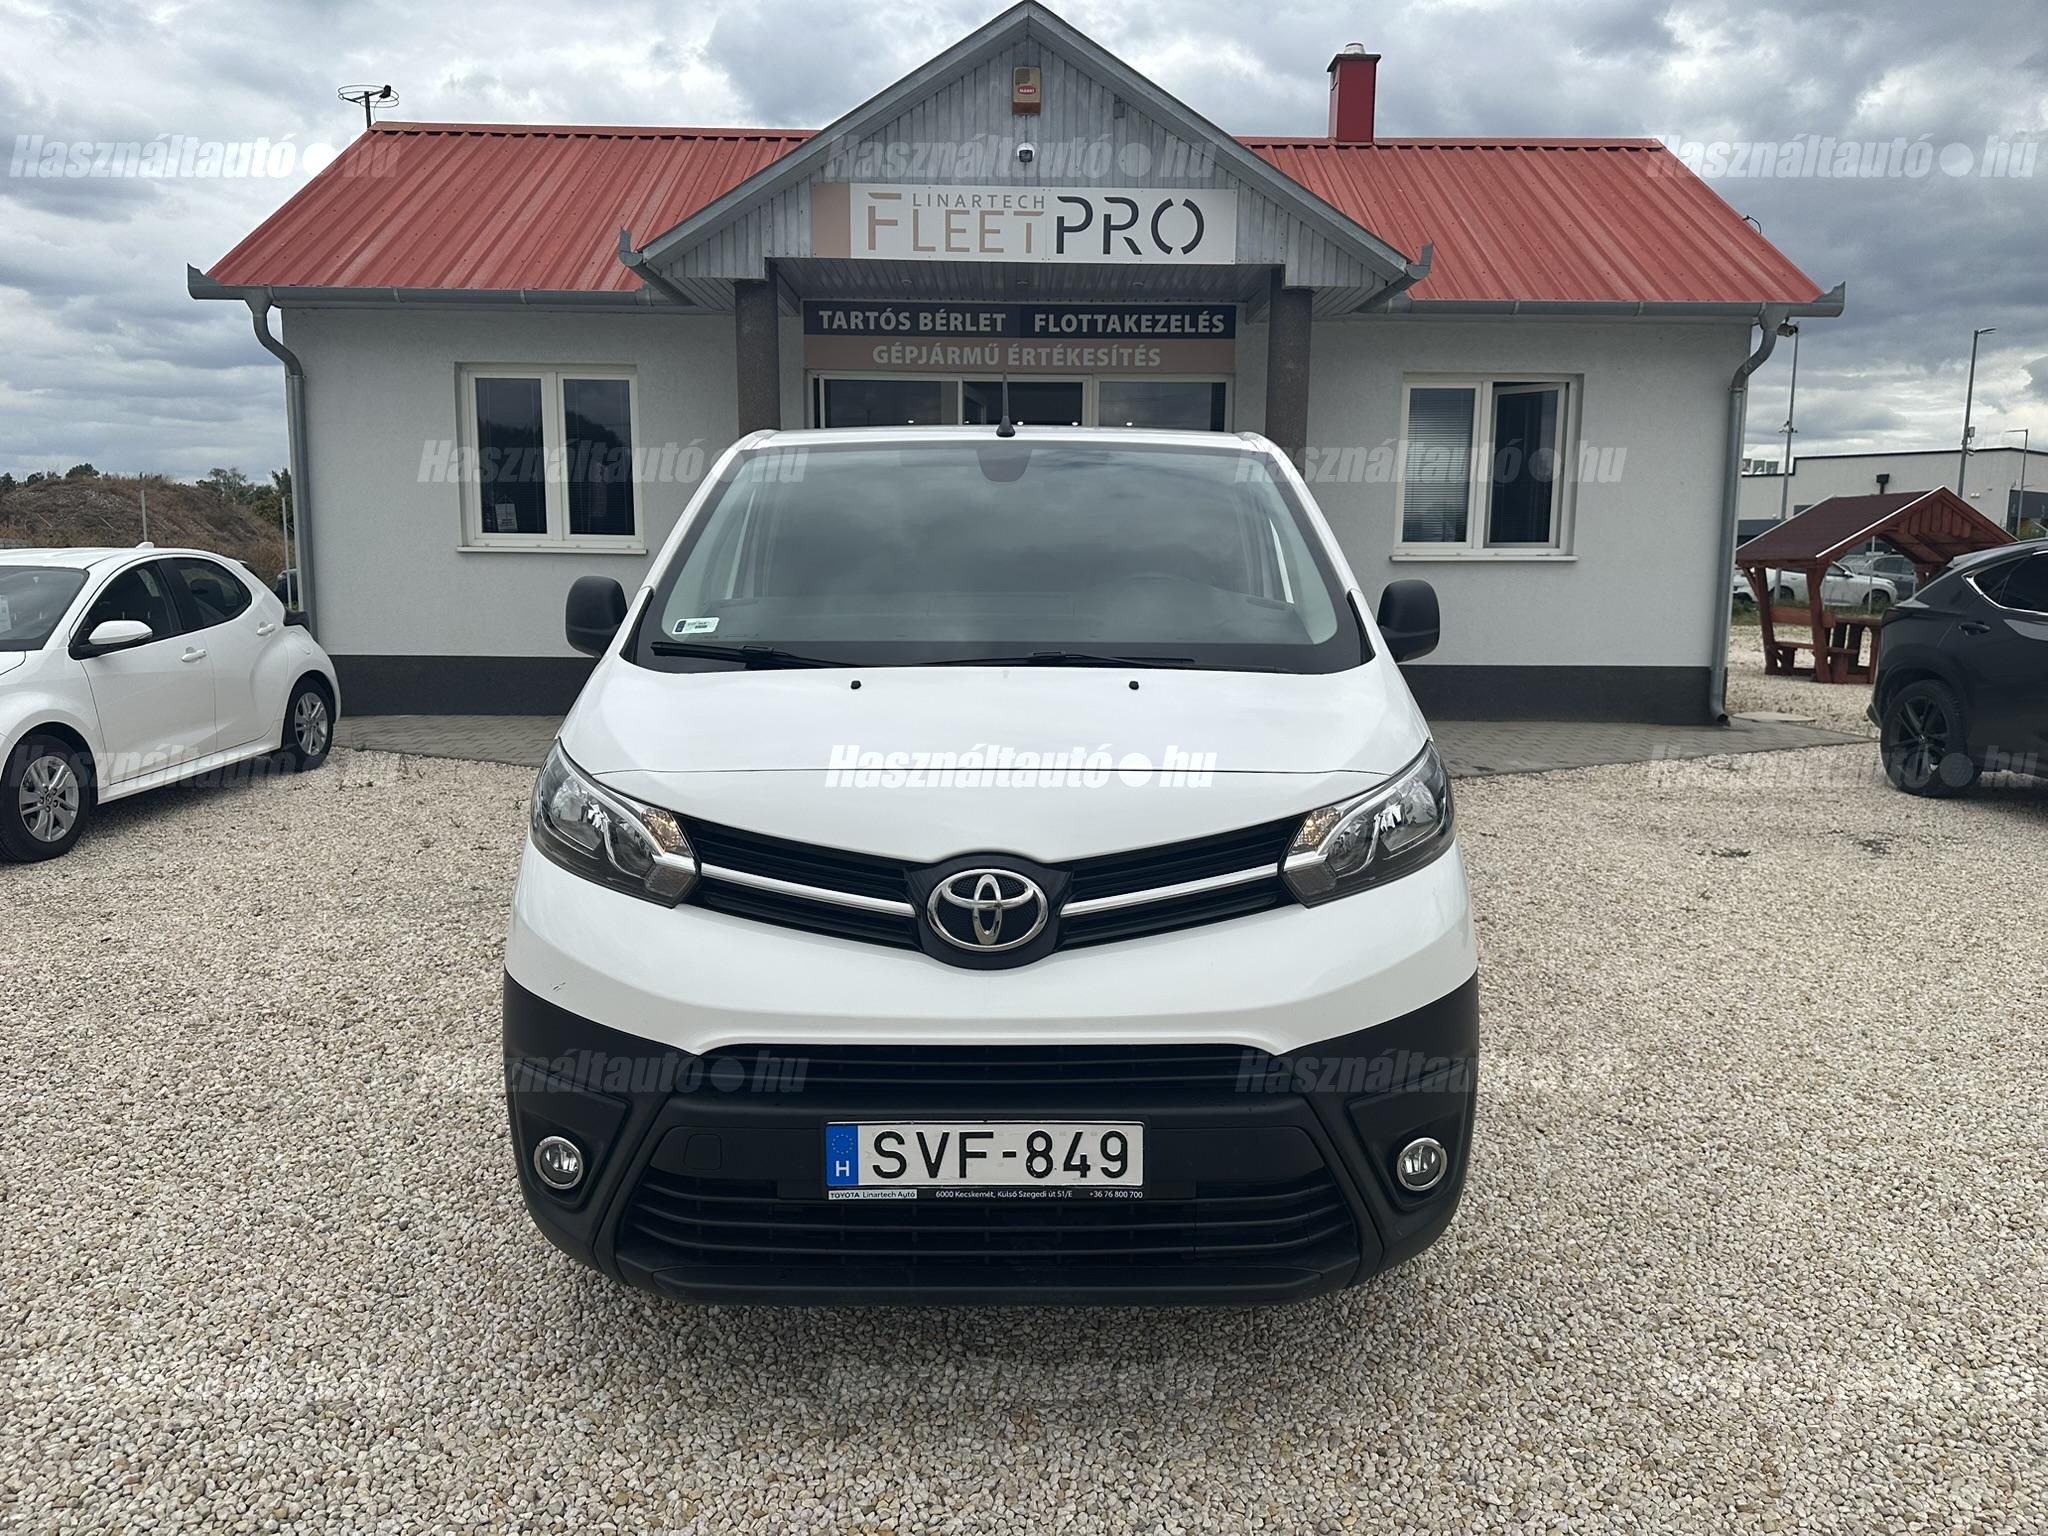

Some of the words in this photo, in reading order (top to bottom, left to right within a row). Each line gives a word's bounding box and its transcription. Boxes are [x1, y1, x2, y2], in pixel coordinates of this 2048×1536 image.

[912, 193, 1045, 209] LINARTECH
[819, 307, 911, 330] TARTÓS
[919, 309, 1006, 332] BÉRLET
[1034, 311, 1225, 333] FLOTTAKEZELÉS
[1007, 343, 1161, 367] ÉRTÉKESÍTÉS
[835, 1160, 850, 1177] H
[872, 1130, 1128, 1179] SVF-849
[935, 1190, 954, 1198] 6000
[1114, 1191, 1128, 1199] 800
[1129, 1191, 1143, 1199] 700
